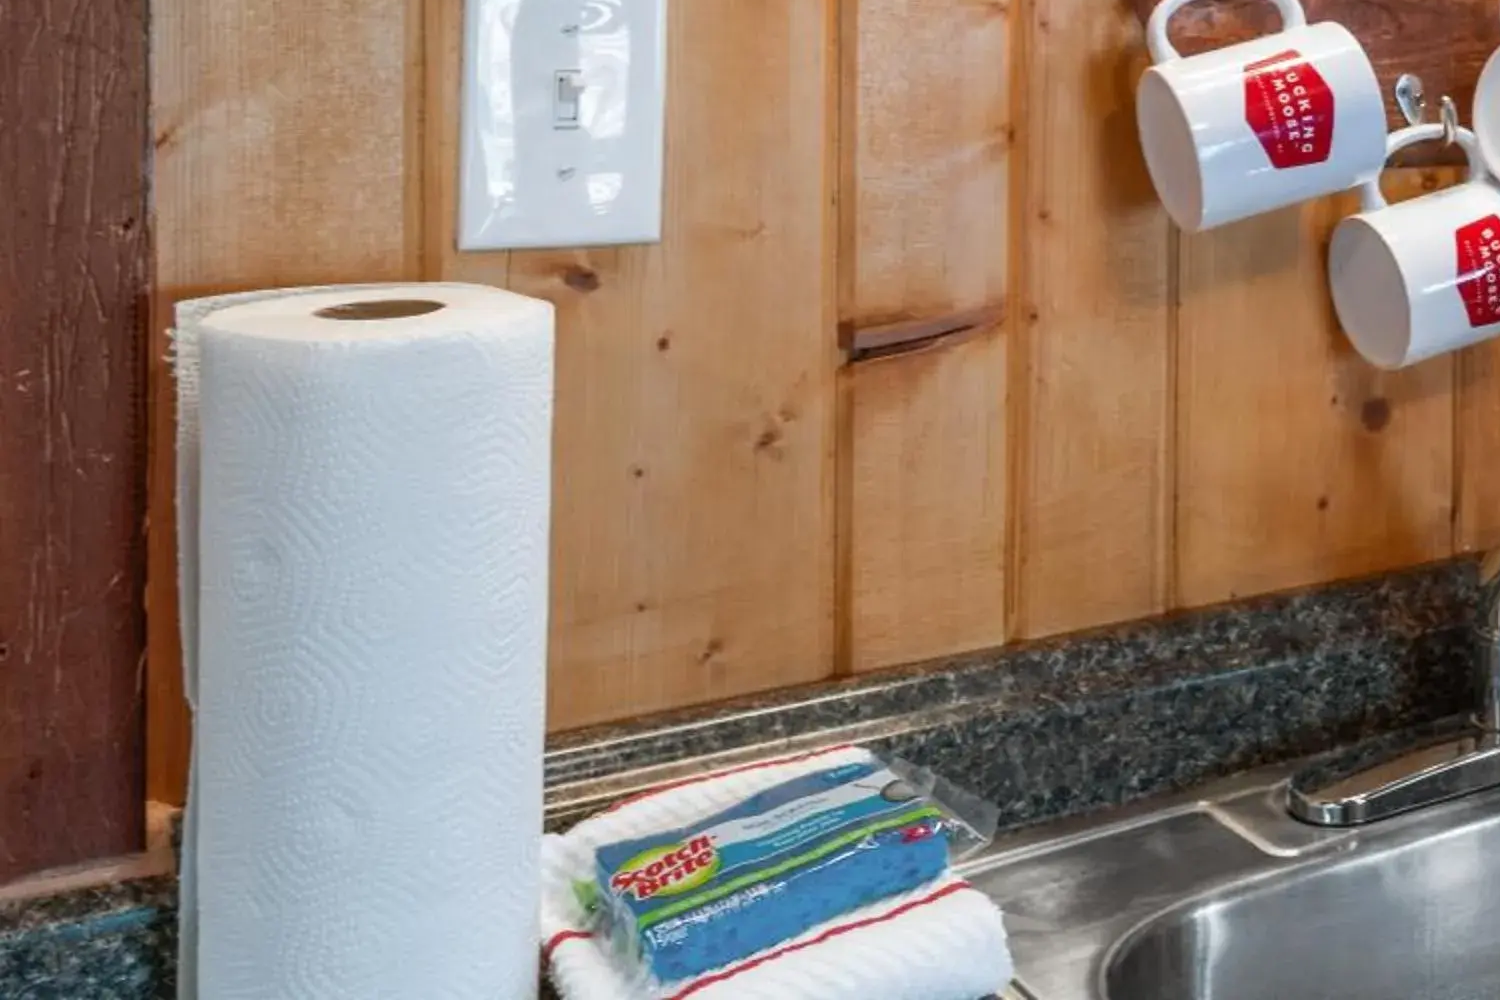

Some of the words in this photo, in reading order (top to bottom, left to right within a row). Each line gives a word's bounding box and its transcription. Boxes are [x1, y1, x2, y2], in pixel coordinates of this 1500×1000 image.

[1271, 78, 1301, 142] MOOSE
[1284, 70, 1316, 154] UCKING
[1478, 245, 1499, 306] MOOSE
[634, 850, 715, 901] Brite
